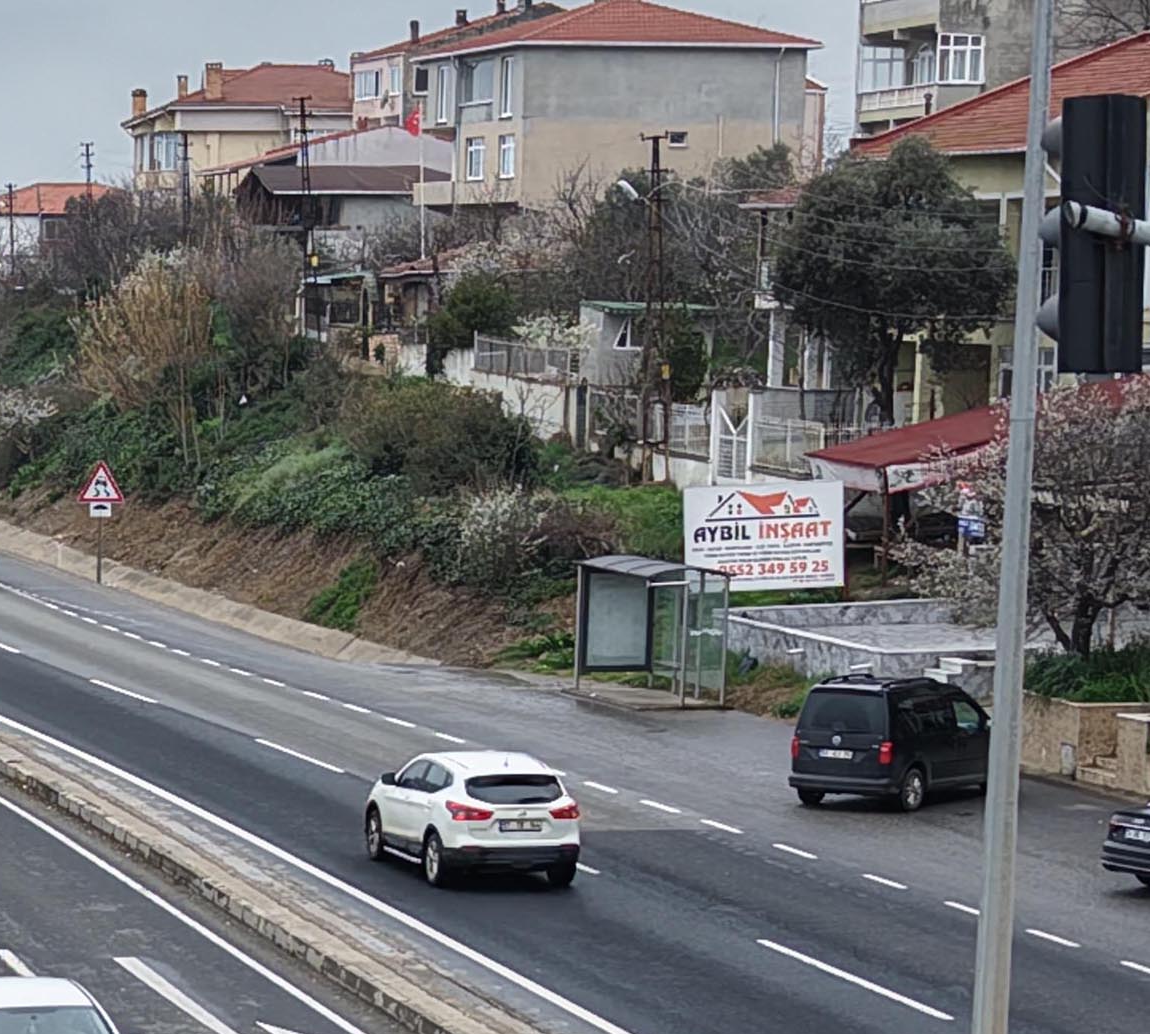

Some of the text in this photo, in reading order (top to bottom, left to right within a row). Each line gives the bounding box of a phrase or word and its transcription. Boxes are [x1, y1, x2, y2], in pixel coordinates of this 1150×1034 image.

[694, 520, 832, 543] AYBİL İNŞAAT
[758, 562, 785, 576] 349
[790, 561, 807, 574] 59
[811, 559, 829, 573] 25
